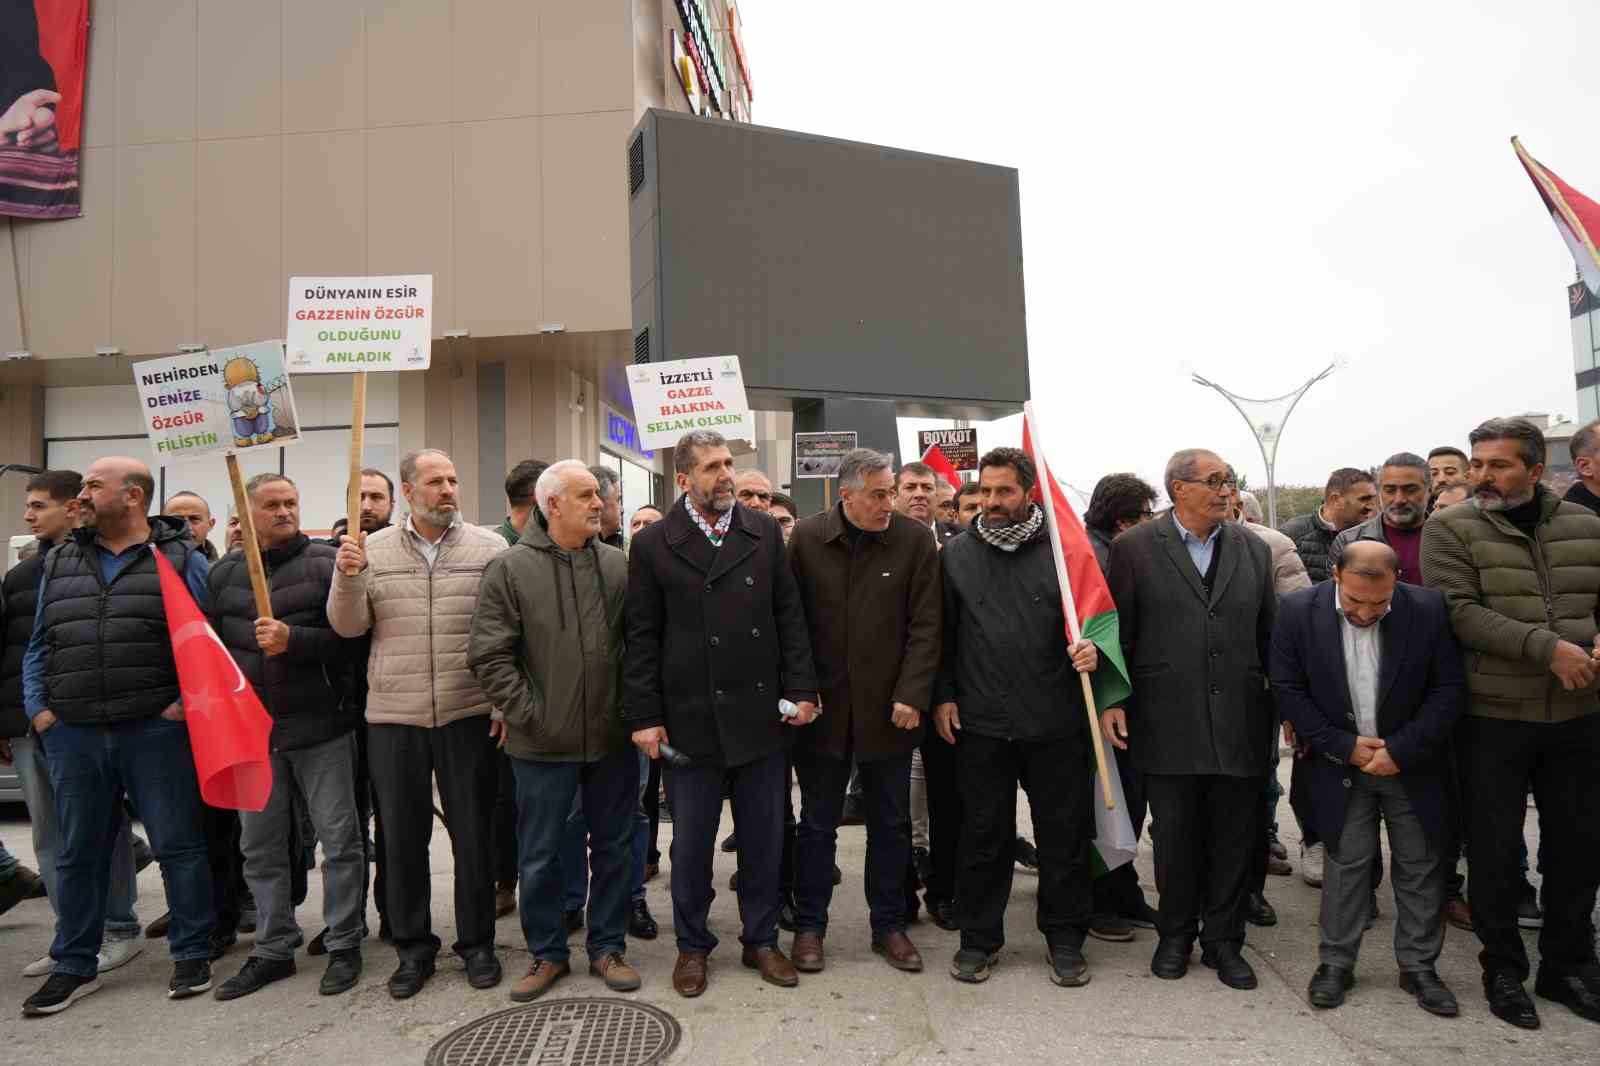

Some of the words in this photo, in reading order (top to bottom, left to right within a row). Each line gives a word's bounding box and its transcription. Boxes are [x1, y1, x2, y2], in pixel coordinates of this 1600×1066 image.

[304, 285, 382, 300] DÜNYANIN
[386, 284, 418, 299] ESİR
[295, 306, 371, 321] GAZZENİN
[374, 305, 425, 320] ÖZGÜR
[317, 327, 401, 342] OLDUĞUNU
[325, 350, 392, 364] ANLADIK
[142, 363, 220, 387] NEHİRDEN
[659, 368, 714, 385] İZZETLİ
[147, 388, 203, 409] DENİZE
[666, 386, 713, 400] GAZZE
[659, 400, 726, 416] HALKINA
[151, 411, 206, 430] ÖZGÜR
[646, 418, 695, 433] SELAM
[697, 414, 743, 427] OLSUN
[157, 431, 218, 453] FİLİSTİN
[923, 430, 972, 445] BOYKOT
